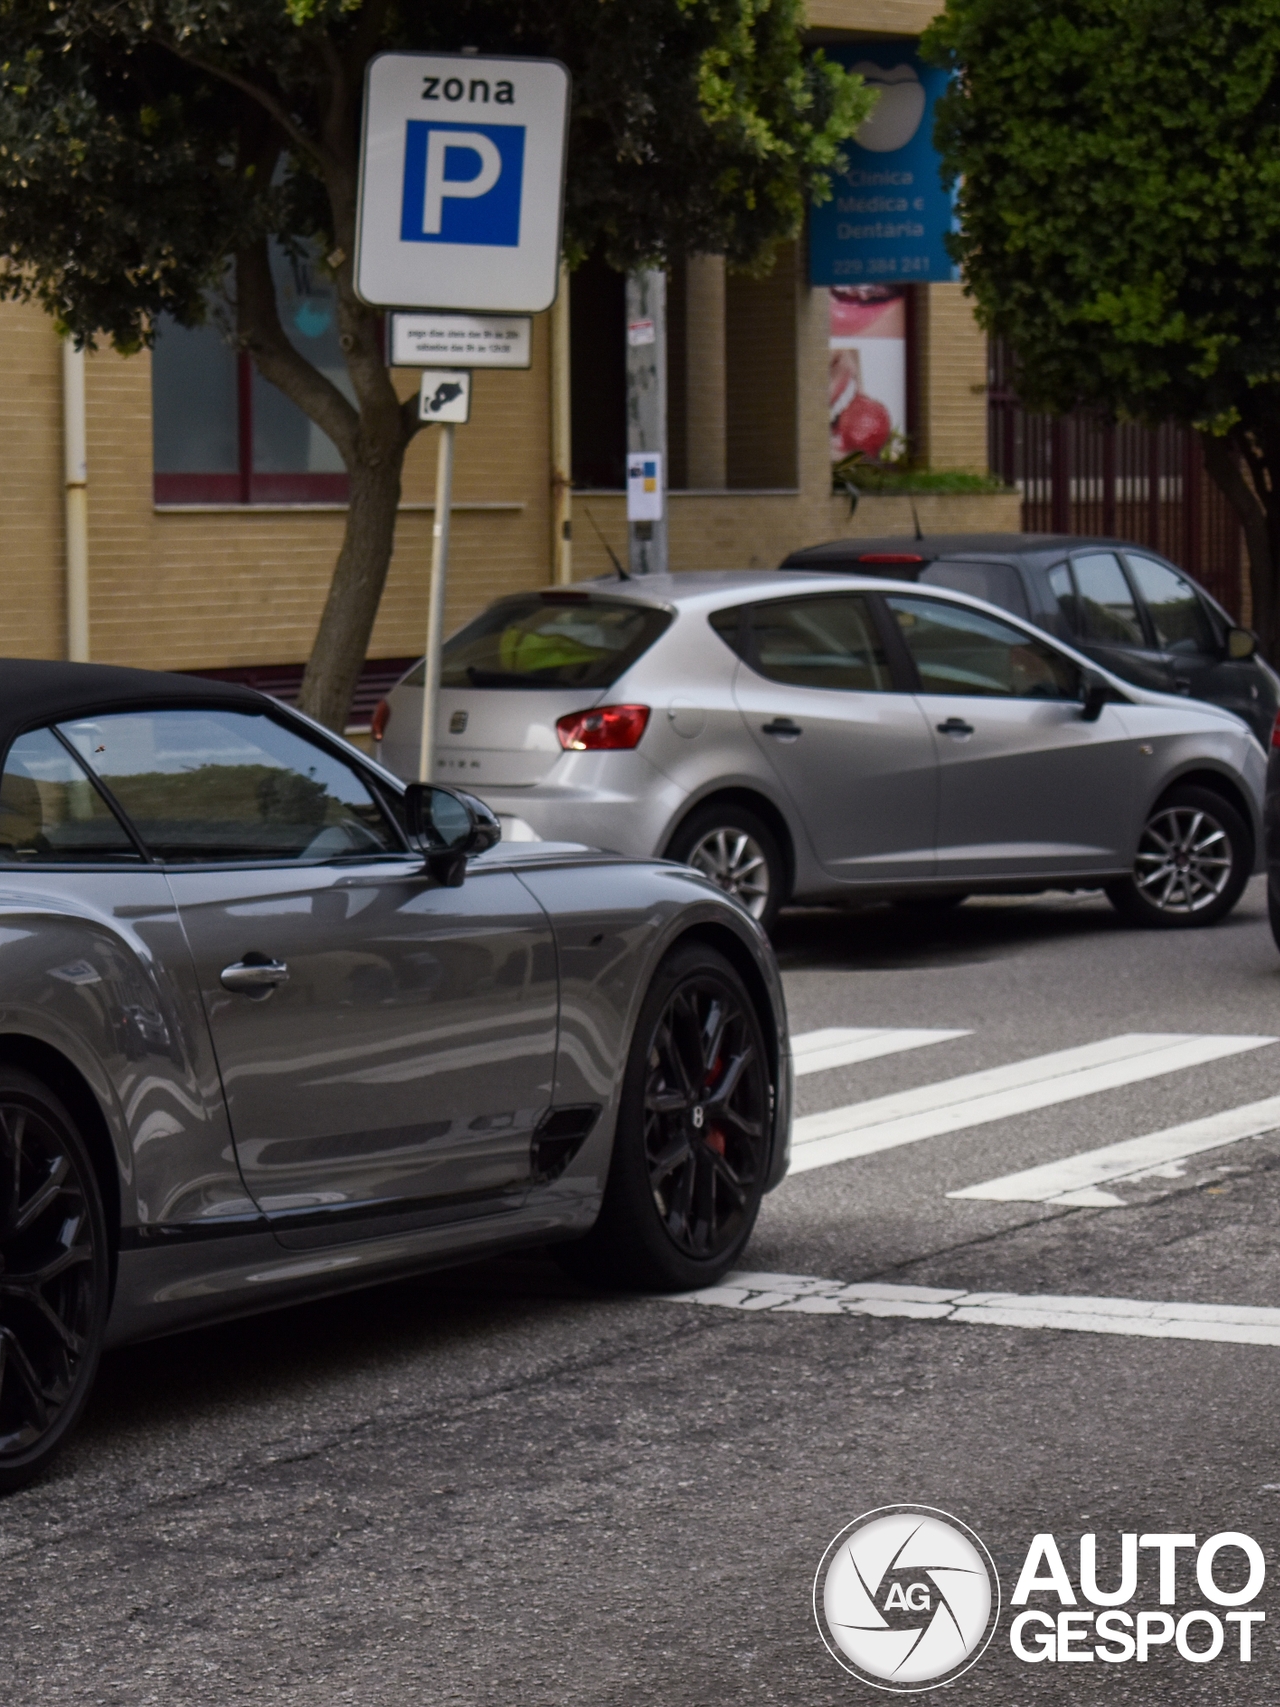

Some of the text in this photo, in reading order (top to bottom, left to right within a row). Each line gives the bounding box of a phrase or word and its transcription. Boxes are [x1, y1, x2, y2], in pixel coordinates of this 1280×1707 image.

[422, 76, 516, 106] zona
[422, 129, 502, 235] P
[901, 257, 929, 273] 241
